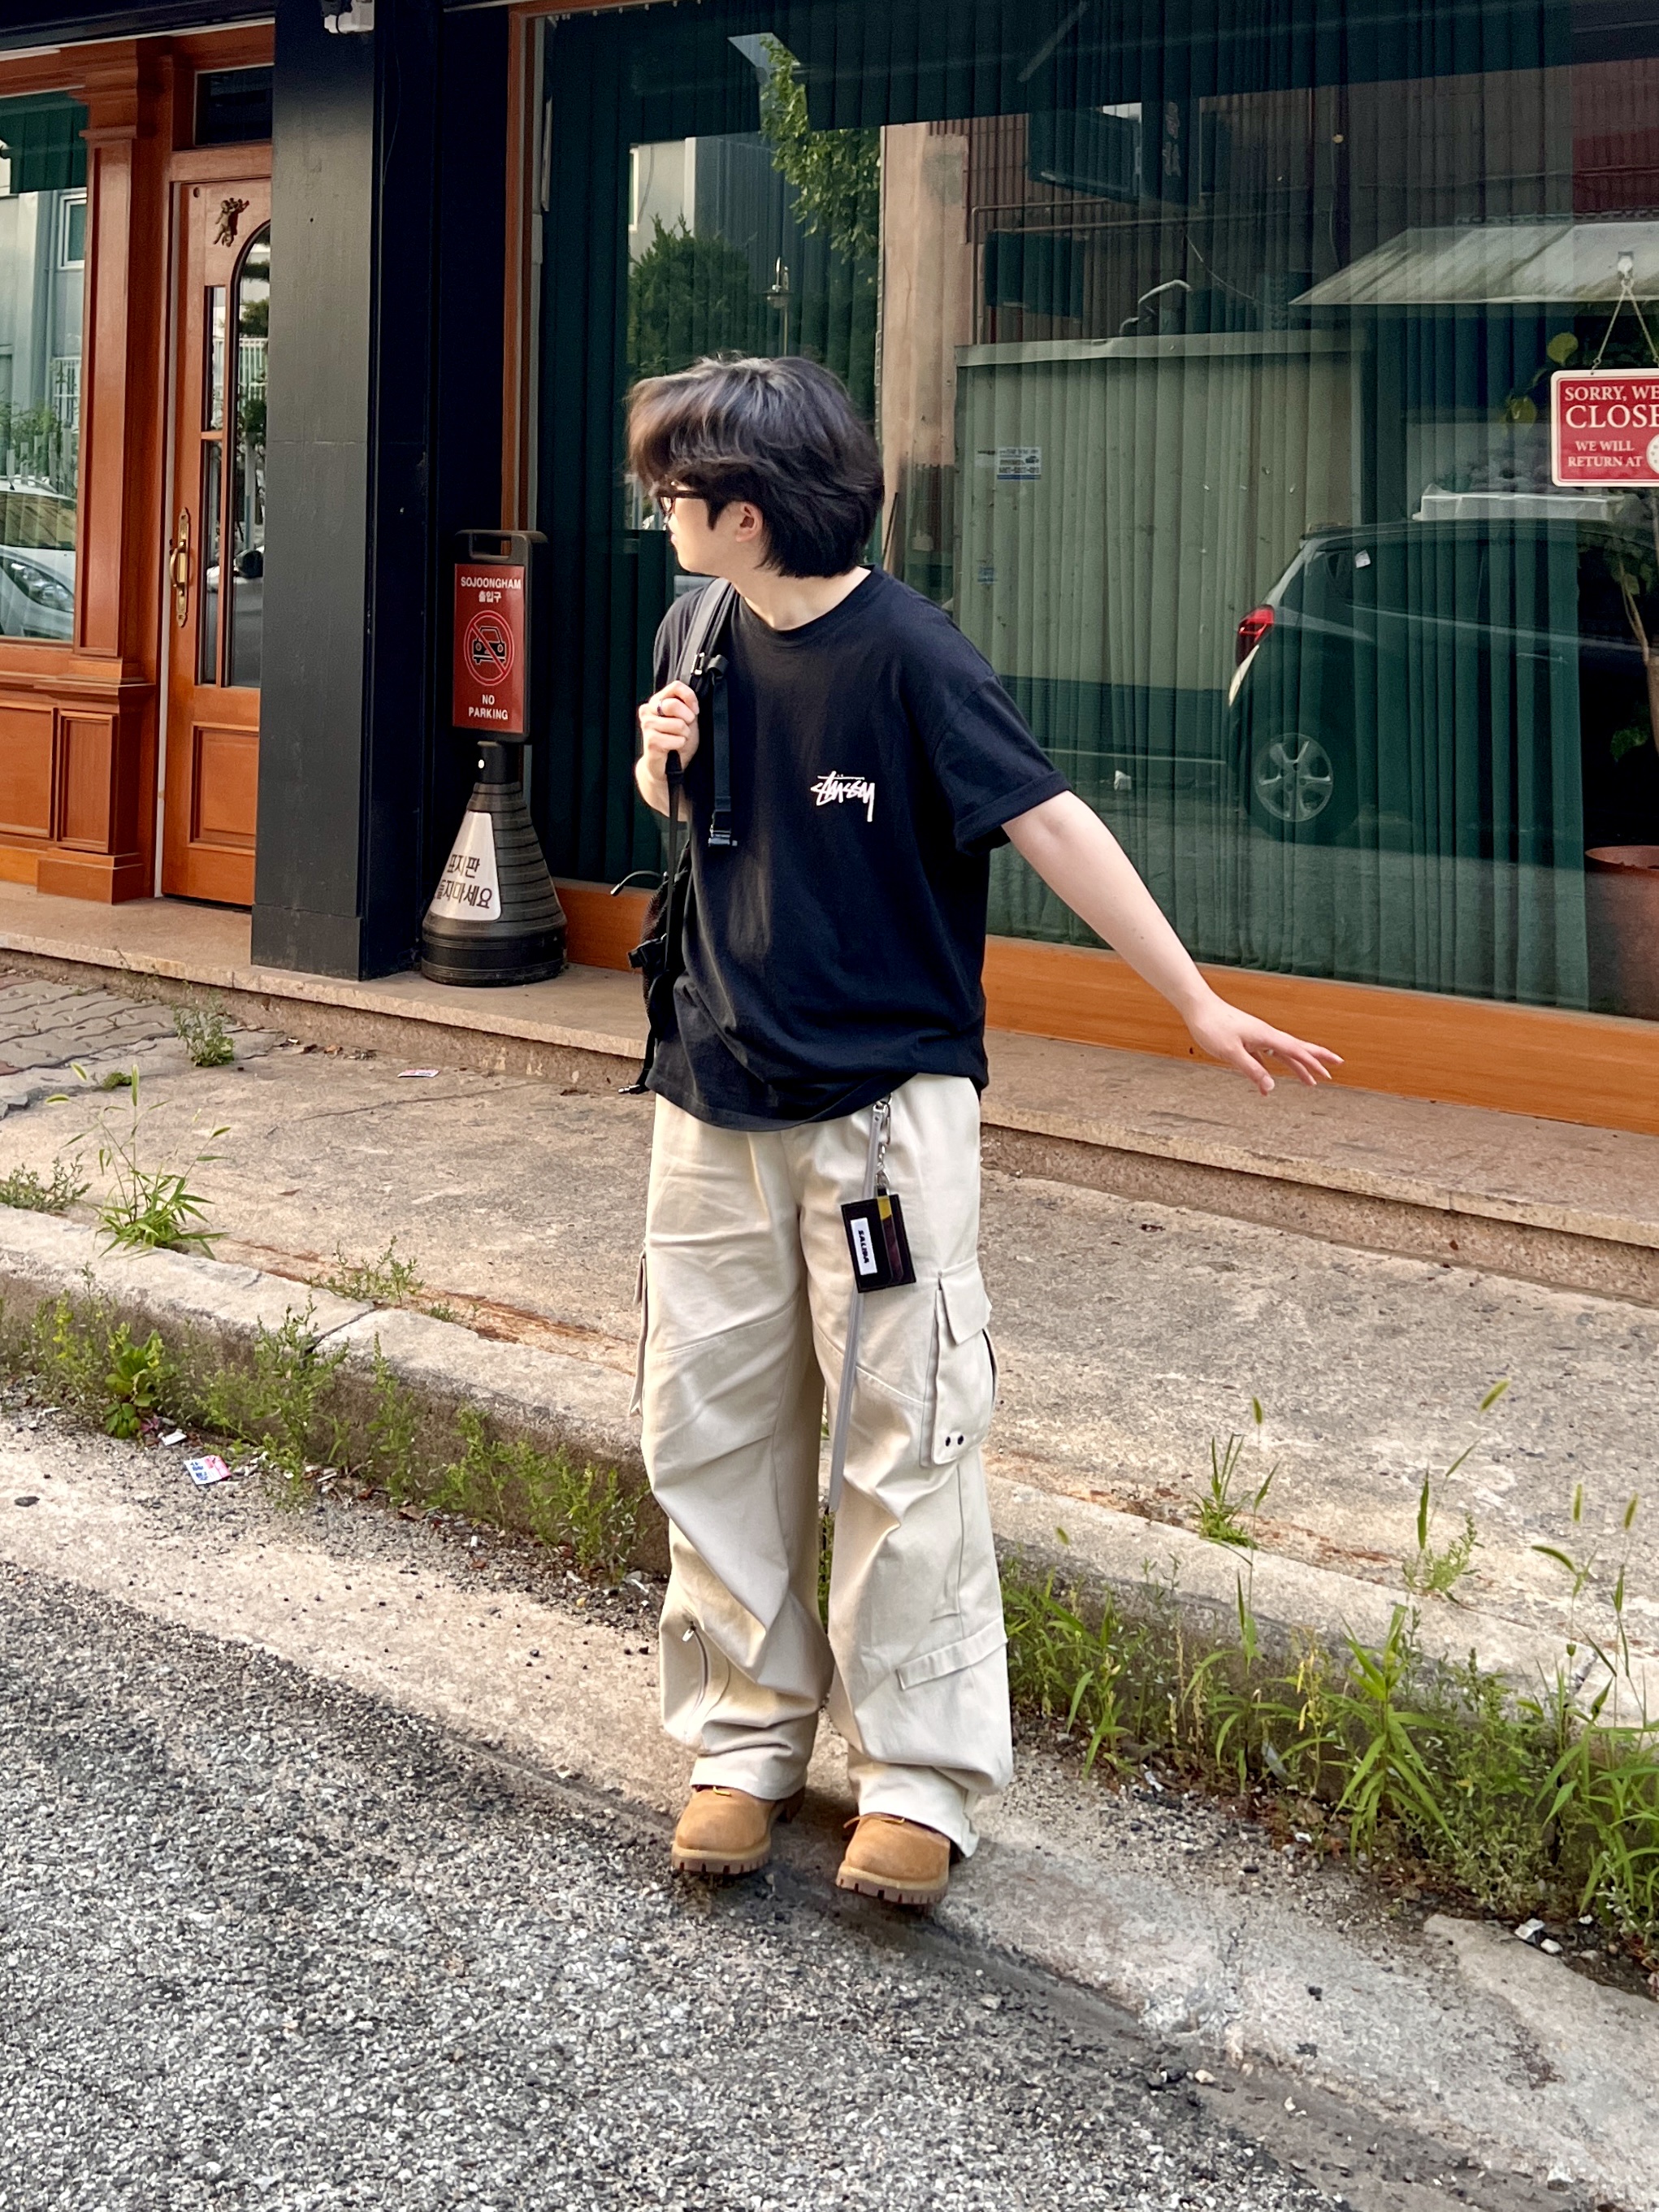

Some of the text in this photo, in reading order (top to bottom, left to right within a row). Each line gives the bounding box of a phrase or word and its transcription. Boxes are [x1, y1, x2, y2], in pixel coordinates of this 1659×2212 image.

[1565, 386, 1627, 401] SORRY,
[1575, 440, 1635, 451] WE WILL
[1568, 456, 1643, 467] RETURN AT
[461, 577, 522, 589] SOJOONGHAM
[479, 591, 502, 603] 출입구
[483, 695, 495, 705] NO
[468, 707, 509, 720] PARKING
